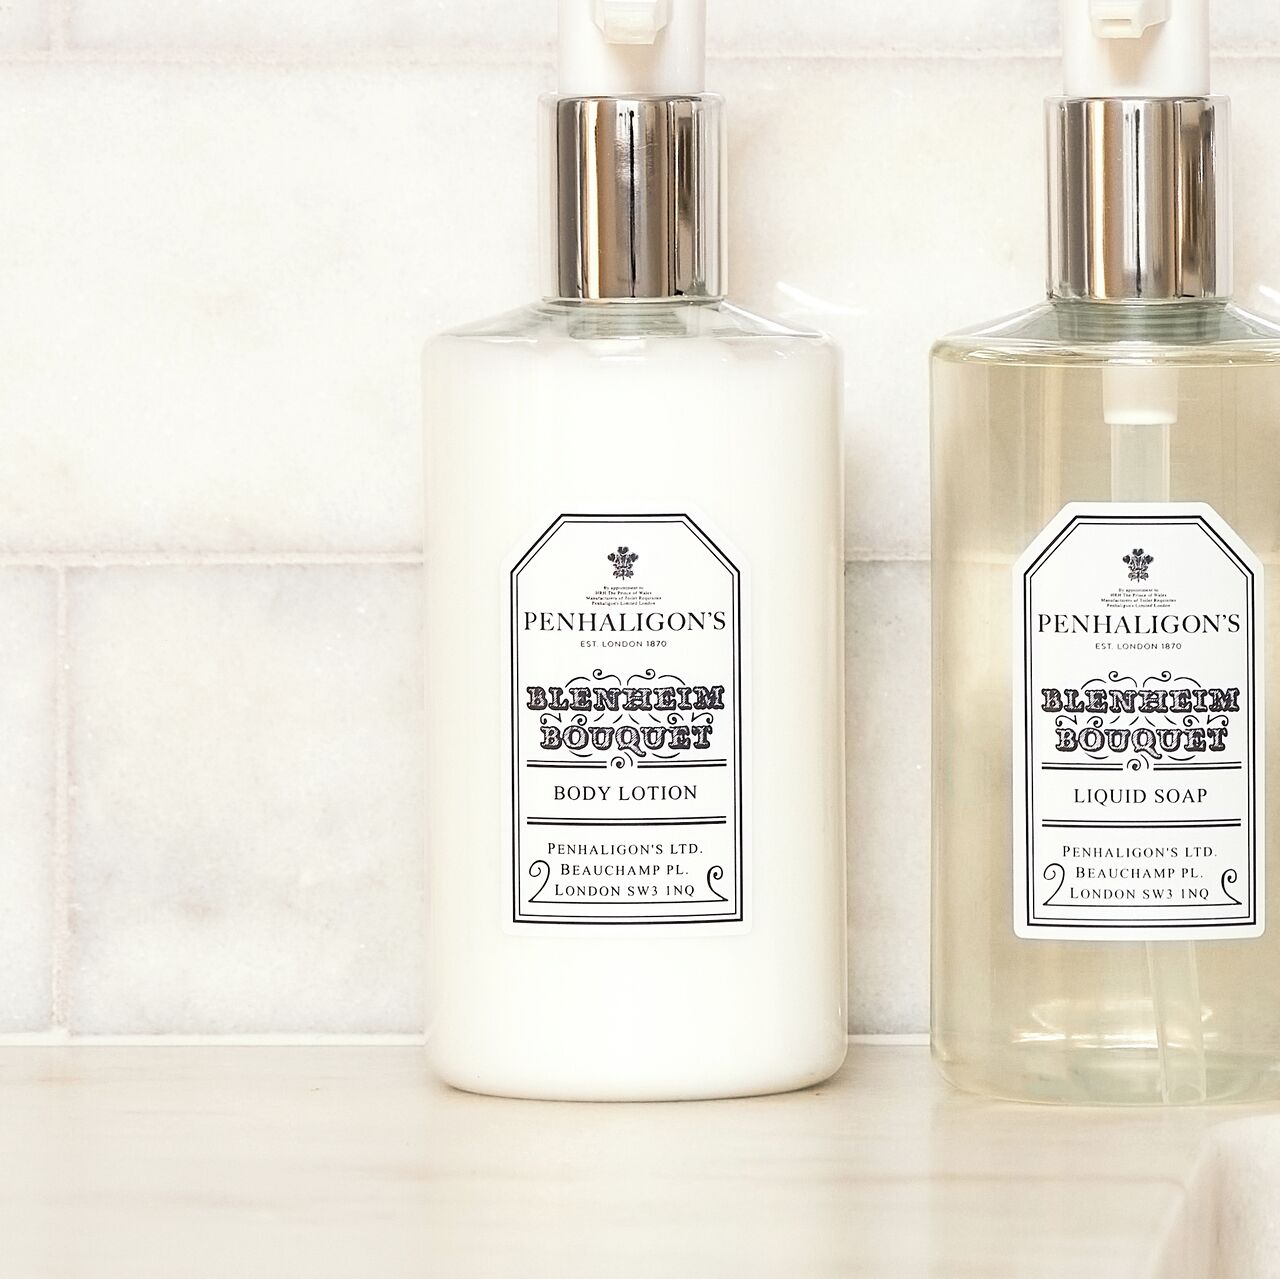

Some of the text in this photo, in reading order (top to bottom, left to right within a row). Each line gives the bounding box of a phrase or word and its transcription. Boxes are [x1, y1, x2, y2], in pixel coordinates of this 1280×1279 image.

[524, 611, 725, 631] PENHALIGON'S
[1038, 614, 1240, 634] PENHALIGON'S
[580, 640, 668, 648] EST. LONDON 1870
[1095, 642, 1182, 651] EST. LONDON 1870
[526, 686, 725, 711] BLENHEIM
[1041, 688, 1240, 712] BLENHEIM
[540, 726, 712, 756] BOUQUET
[1055, 728, 1228, 759] BOUQUET
[554, 785, 696, 800] BODY LOTION
[1075, 789, 1207, 806] LIQUID SOAP
[548, 843, 702, 855] PENHALIGON'S LTD.
[1063, 846, 1216, 858] PENHALIGON'S LTD.
[561, 864, 688, 876] BEAUCHAMP PL.
[1076, 867, 1203, 878] BEAUCHAMP PL.
[555, 884, 620, 896] LONDON
[628, 886, 657, 896] SW3
[1071, 887, 1135, 899] LONDON
[1143, 889, 1172, 899] SW3
